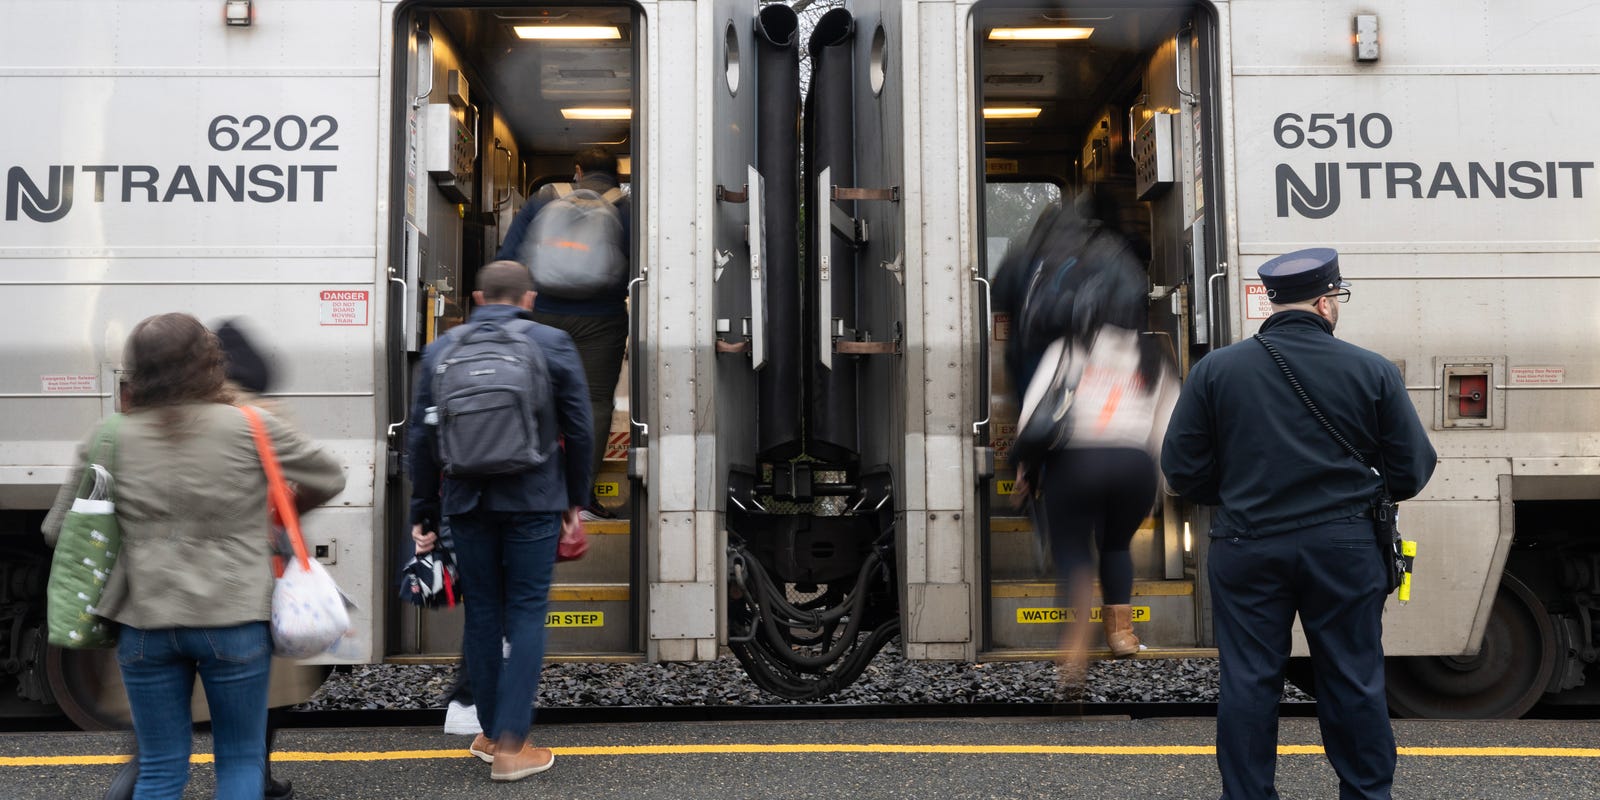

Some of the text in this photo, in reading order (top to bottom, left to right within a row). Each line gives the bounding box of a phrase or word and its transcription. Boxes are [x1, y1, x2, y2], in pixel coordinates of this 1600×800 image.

[208, 115, 338, 151] 6202
[1274, 113, 1392, 149] 6510
[6, 165, 337, 223] NJ TRANSIT
[1276, 161, 1594, 219] NJ TRANSIT
[324, 292, 365, 300] DANGER
[595, 485, 613, 494] EP
[545, 614, 598, 624] UR STEP
[1023, 610, 1067, 620] WATCH
